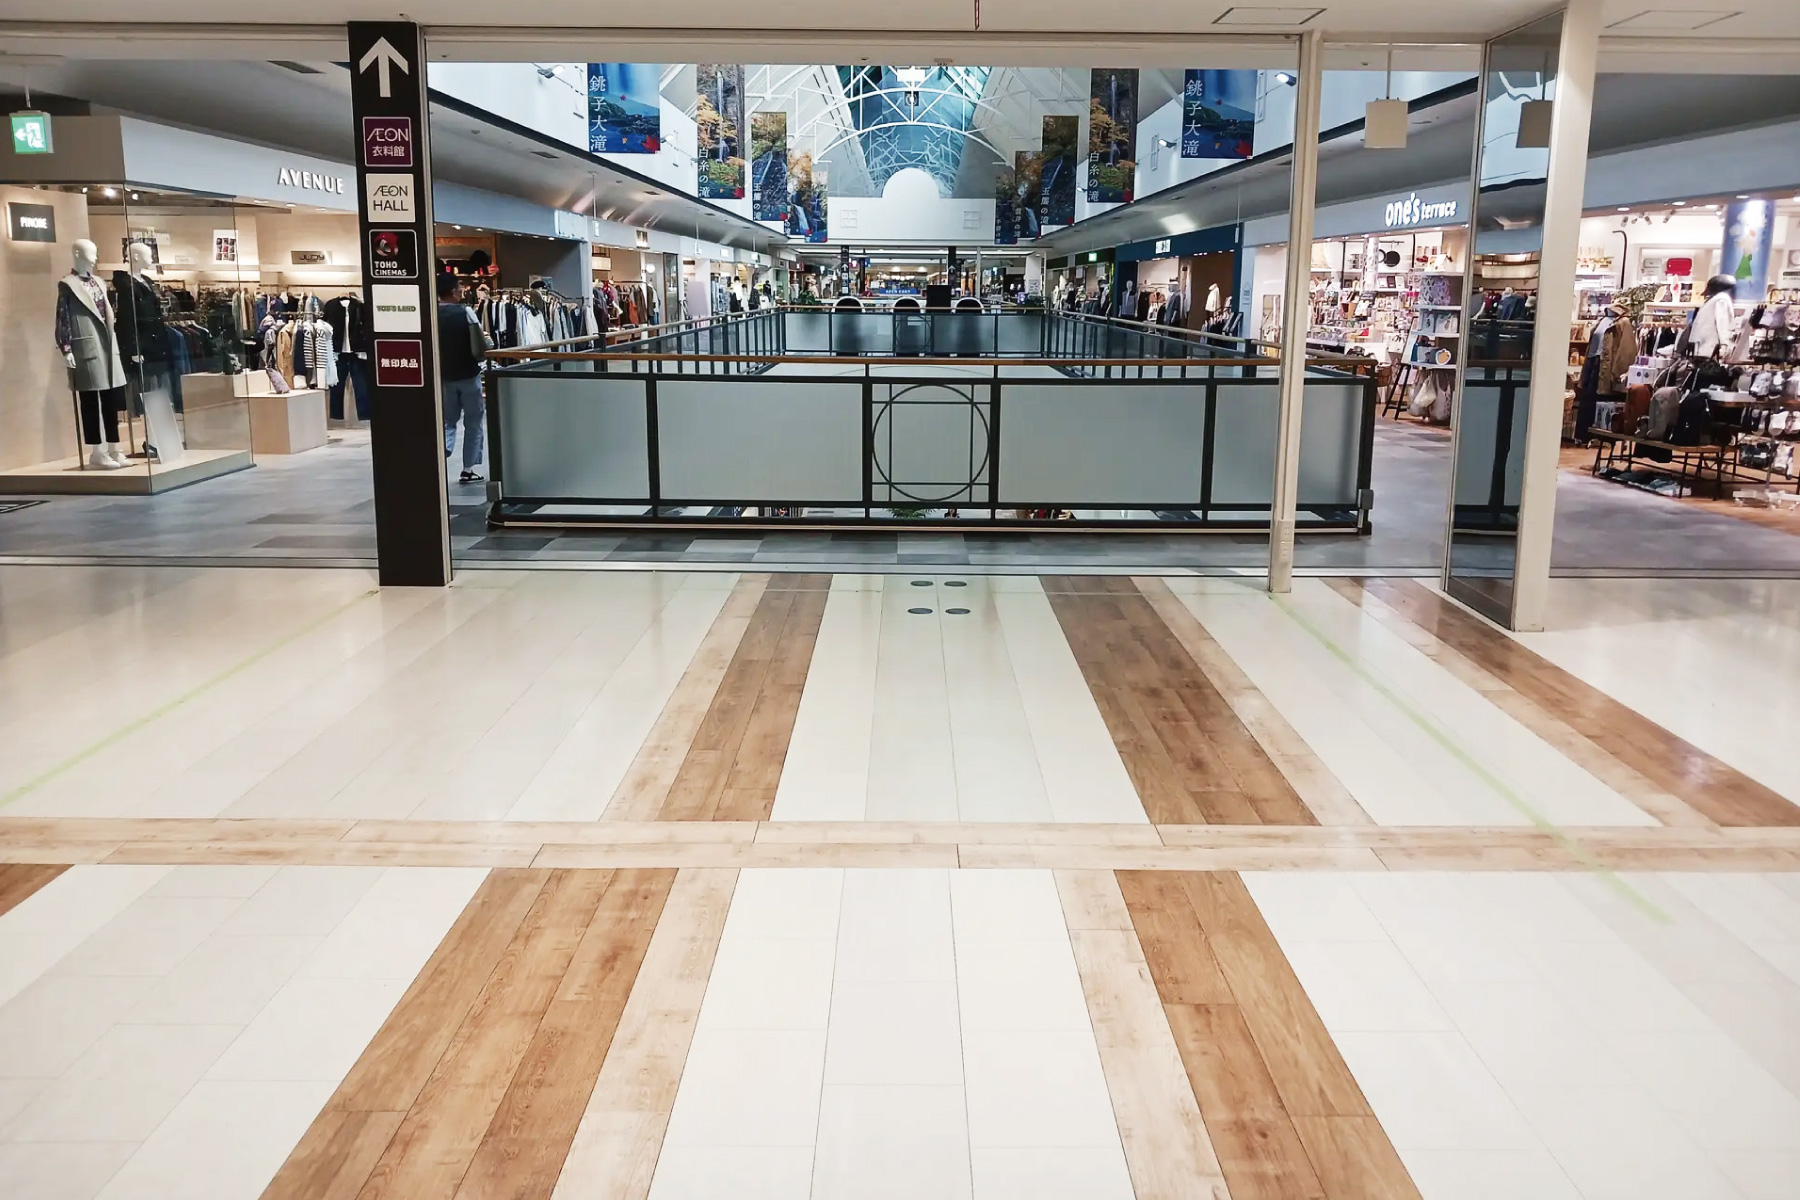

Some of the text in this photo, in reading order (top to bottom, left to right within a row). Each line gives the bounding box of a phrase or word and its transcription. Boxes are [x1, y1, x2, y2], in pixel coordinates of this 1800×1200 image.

[588, 74, 608, 152] 銚子大滝
[1182, 79, 1203, 157] 銚子大滝
[372, 145, 405, 157] 衣料館
[277, 167, 344, 195] AVENUE
[698, 146, 710, 198] 白糸の滝
[1088, 150, 1100, 202] 白糸の滝
[373, 199, 409, 212] HALL
[1385, 192, 1457, 227] one's terrace
[374, 261, 398, 269] TOHO
[380, 357, 419, 368] 無印良品
